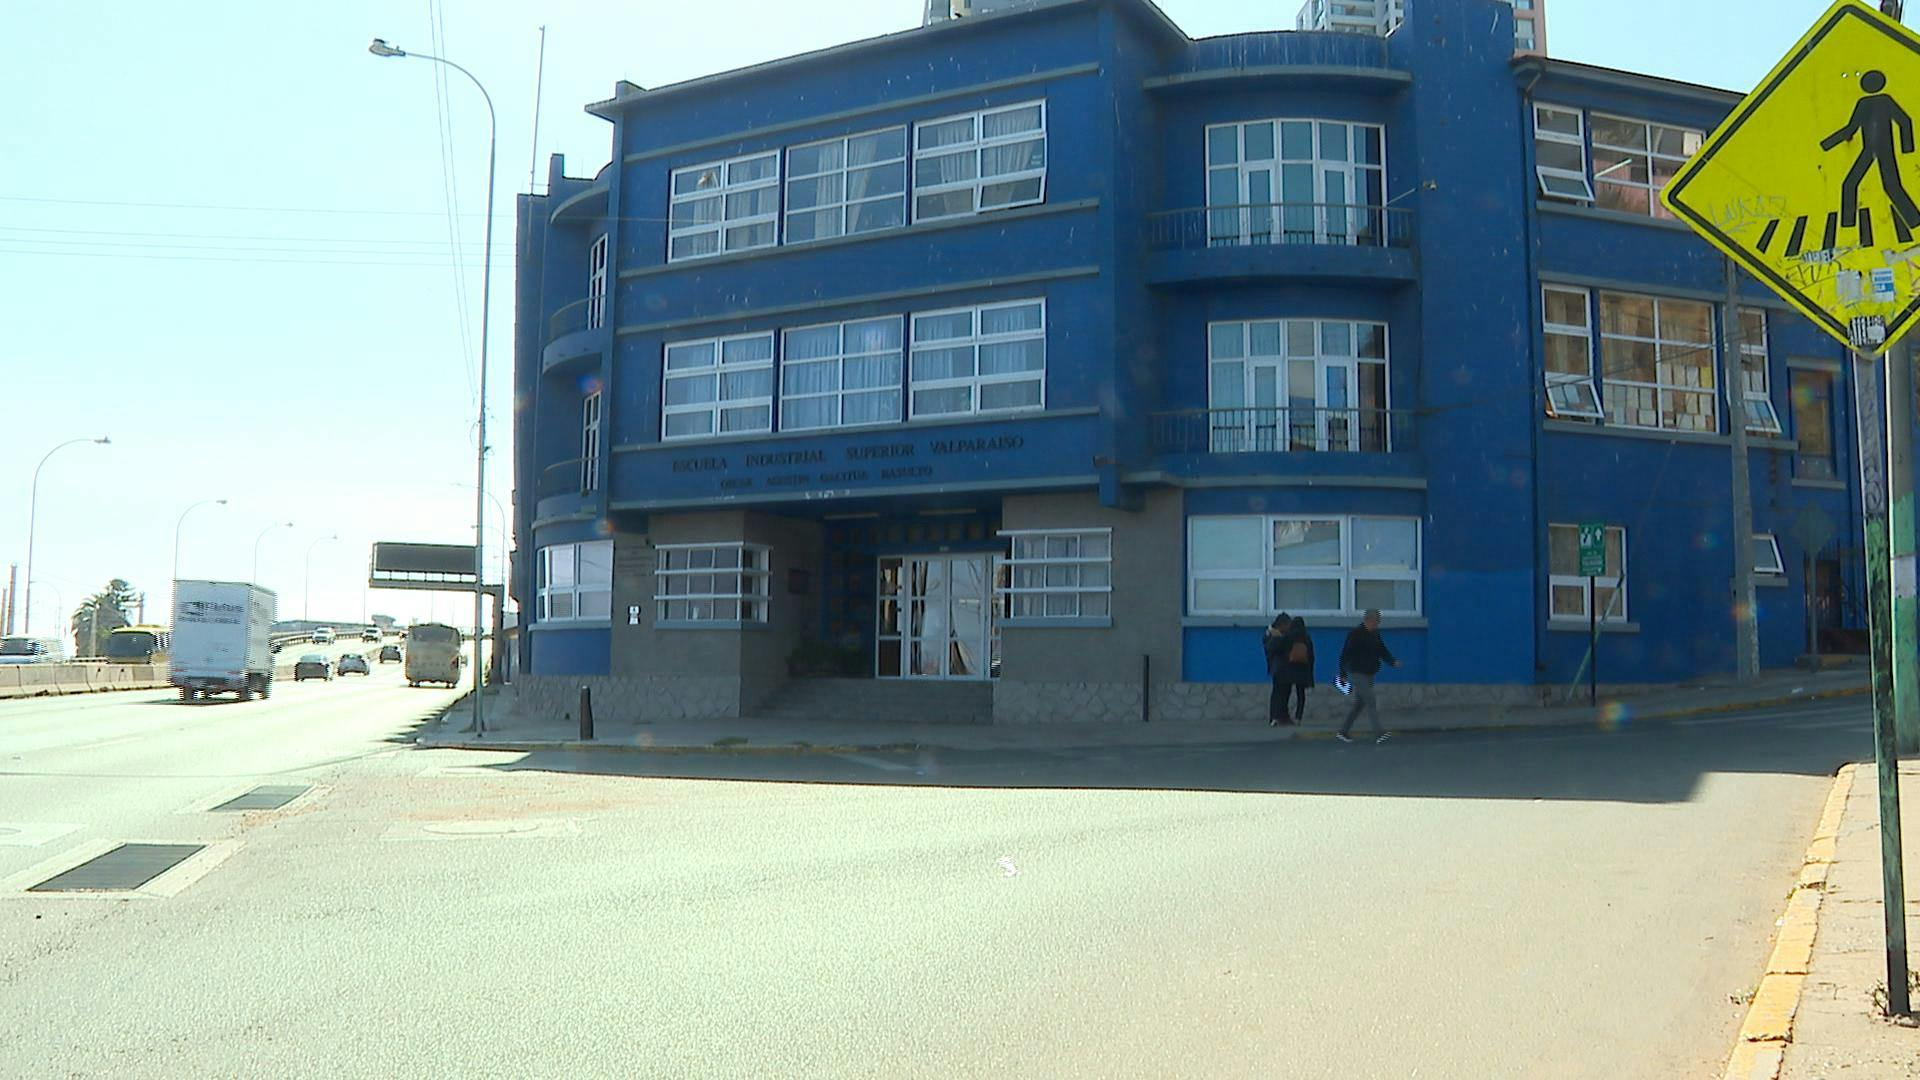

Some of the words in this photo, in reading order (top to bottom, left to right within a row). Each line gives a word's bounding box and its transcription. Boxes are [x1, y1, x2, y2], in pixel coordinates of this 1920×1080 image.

[672, 457, 728, 473] ESCUELA
[745, 449, 826, 468] INDUSTRIAL
[846, 443, 915, 460] SUPERIOR
